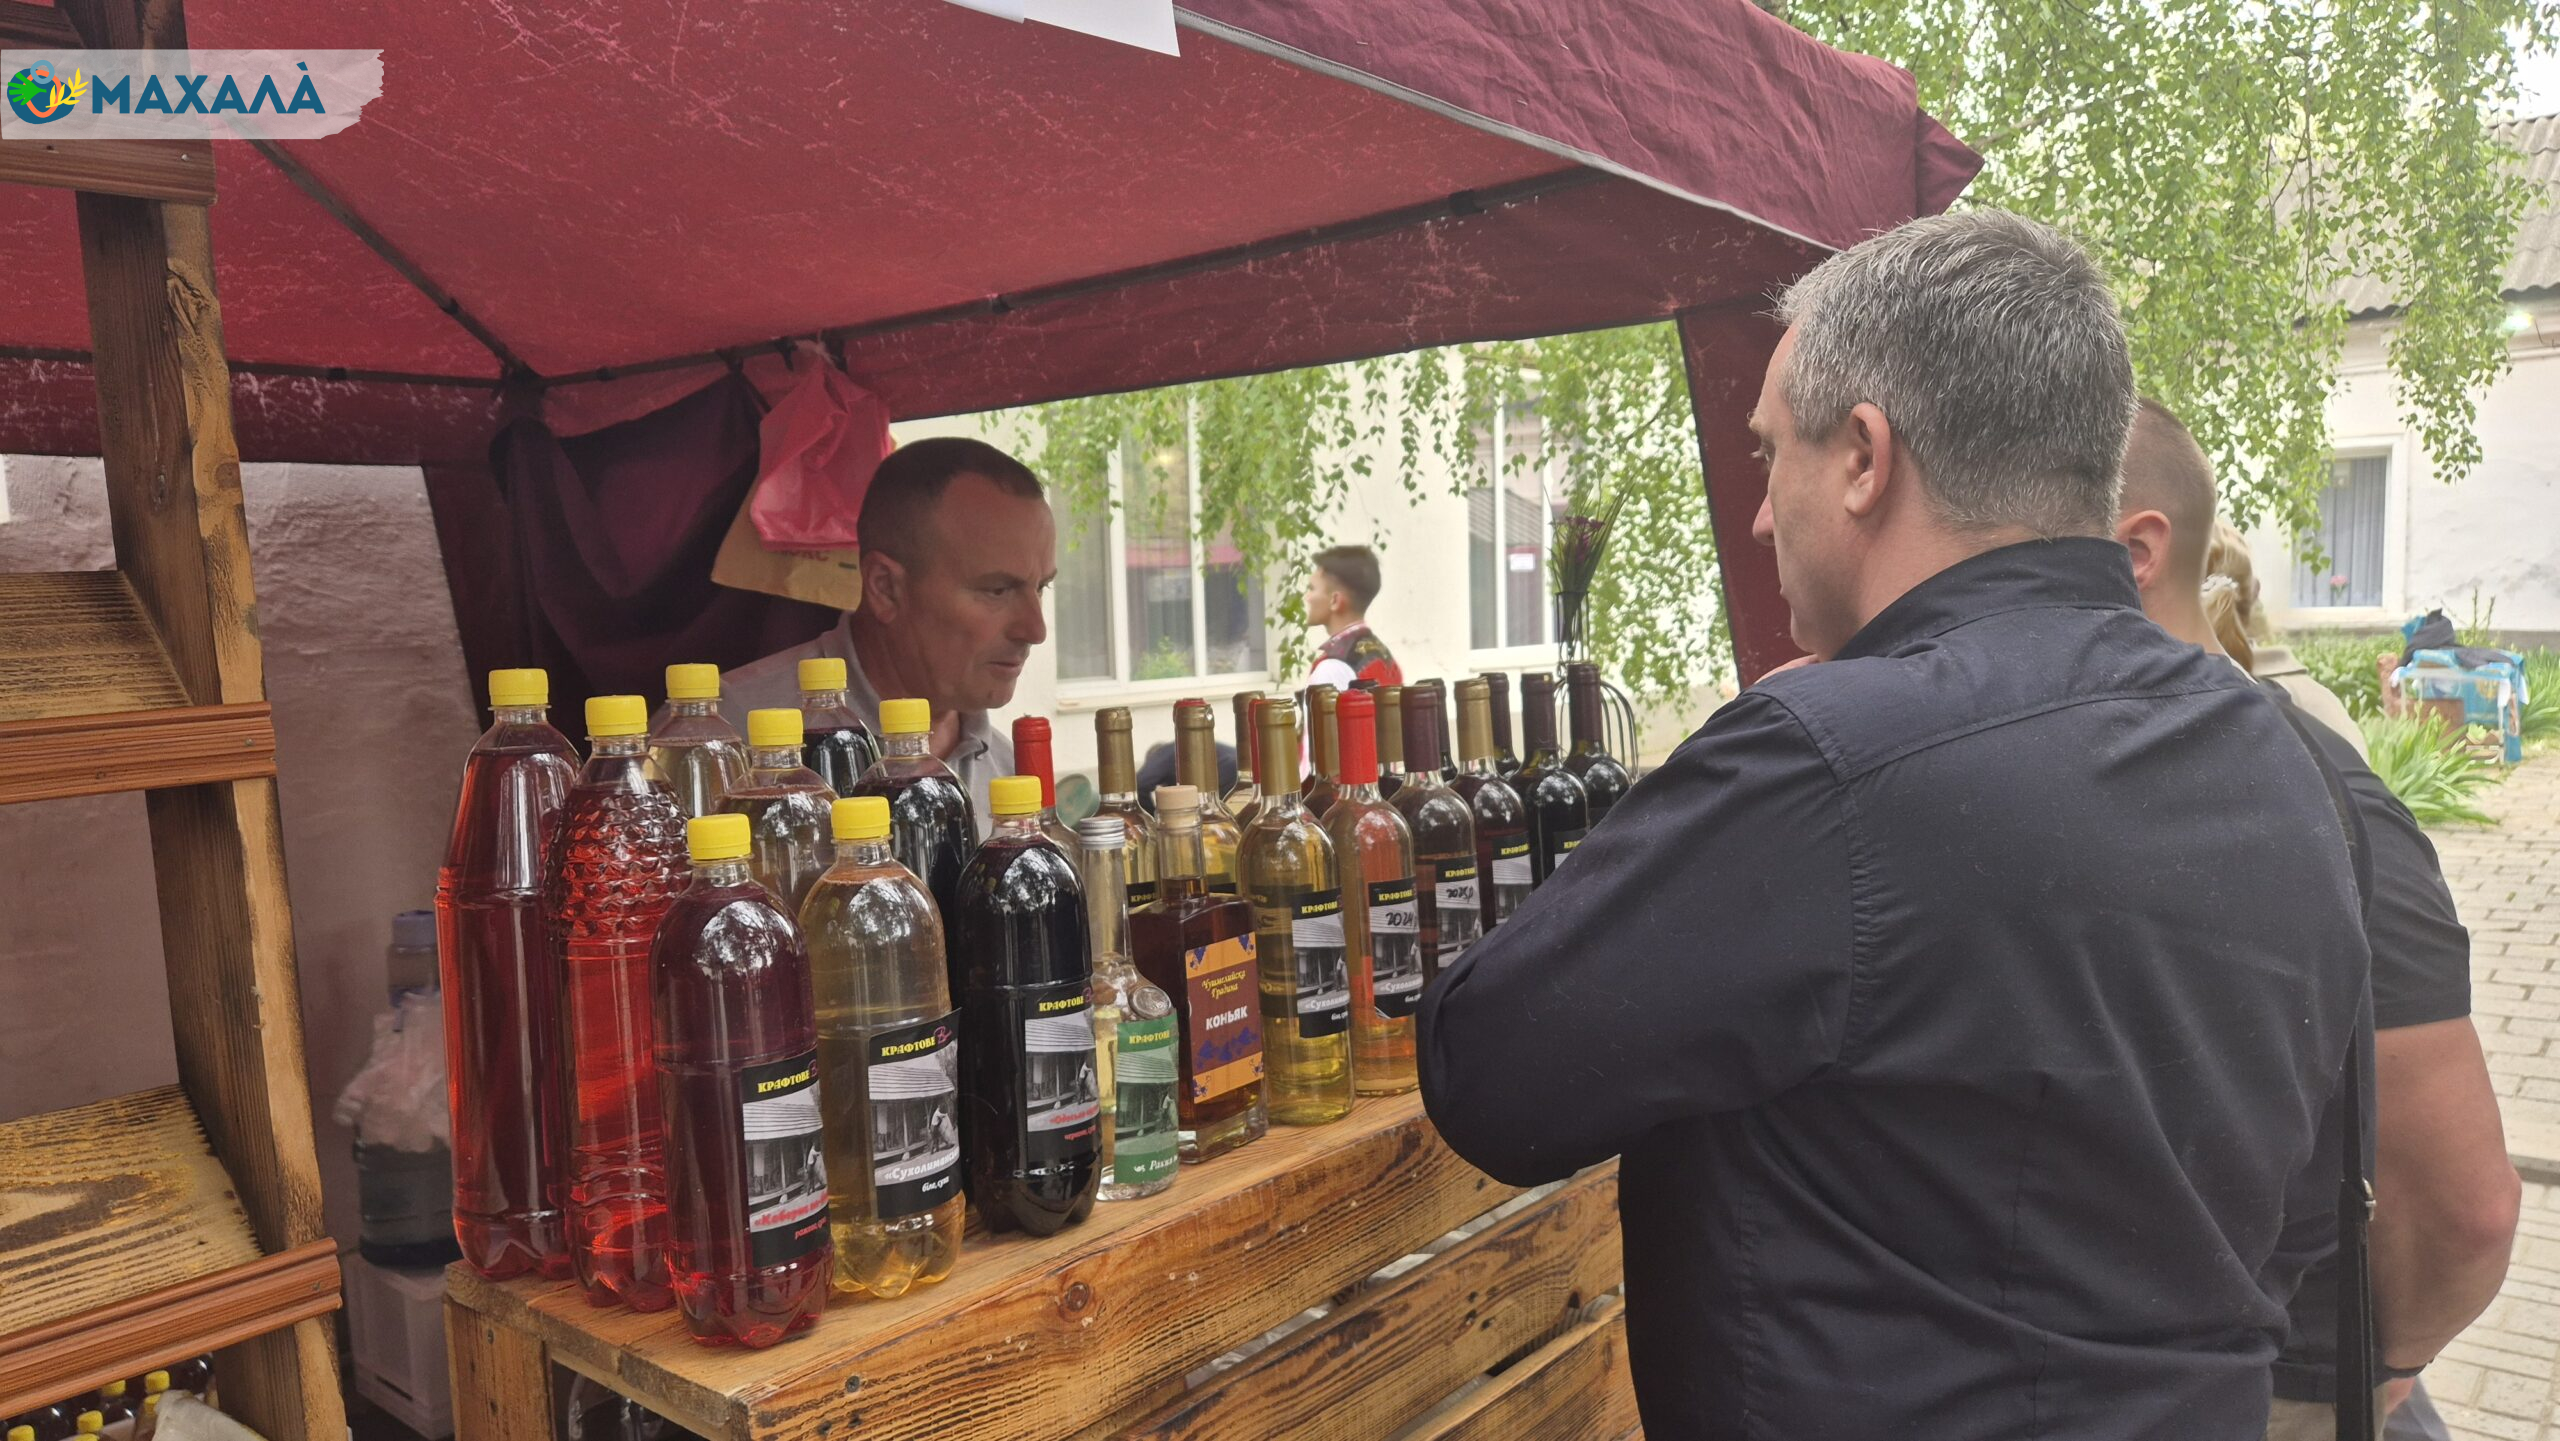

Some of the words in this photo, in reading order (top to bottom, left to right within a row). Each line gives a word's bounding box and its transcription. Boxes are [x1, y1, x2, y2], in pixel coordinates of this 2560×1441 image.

[1039, 995, 1084, 1012] КРАФТОВЕ
[1206, 1005, 1248, 1031] КОНЬЯК
[881, 1036, 936, 1057] КРАФТОВЕ
[757, 1069, 811, 1094] КРАФТОВЕ
